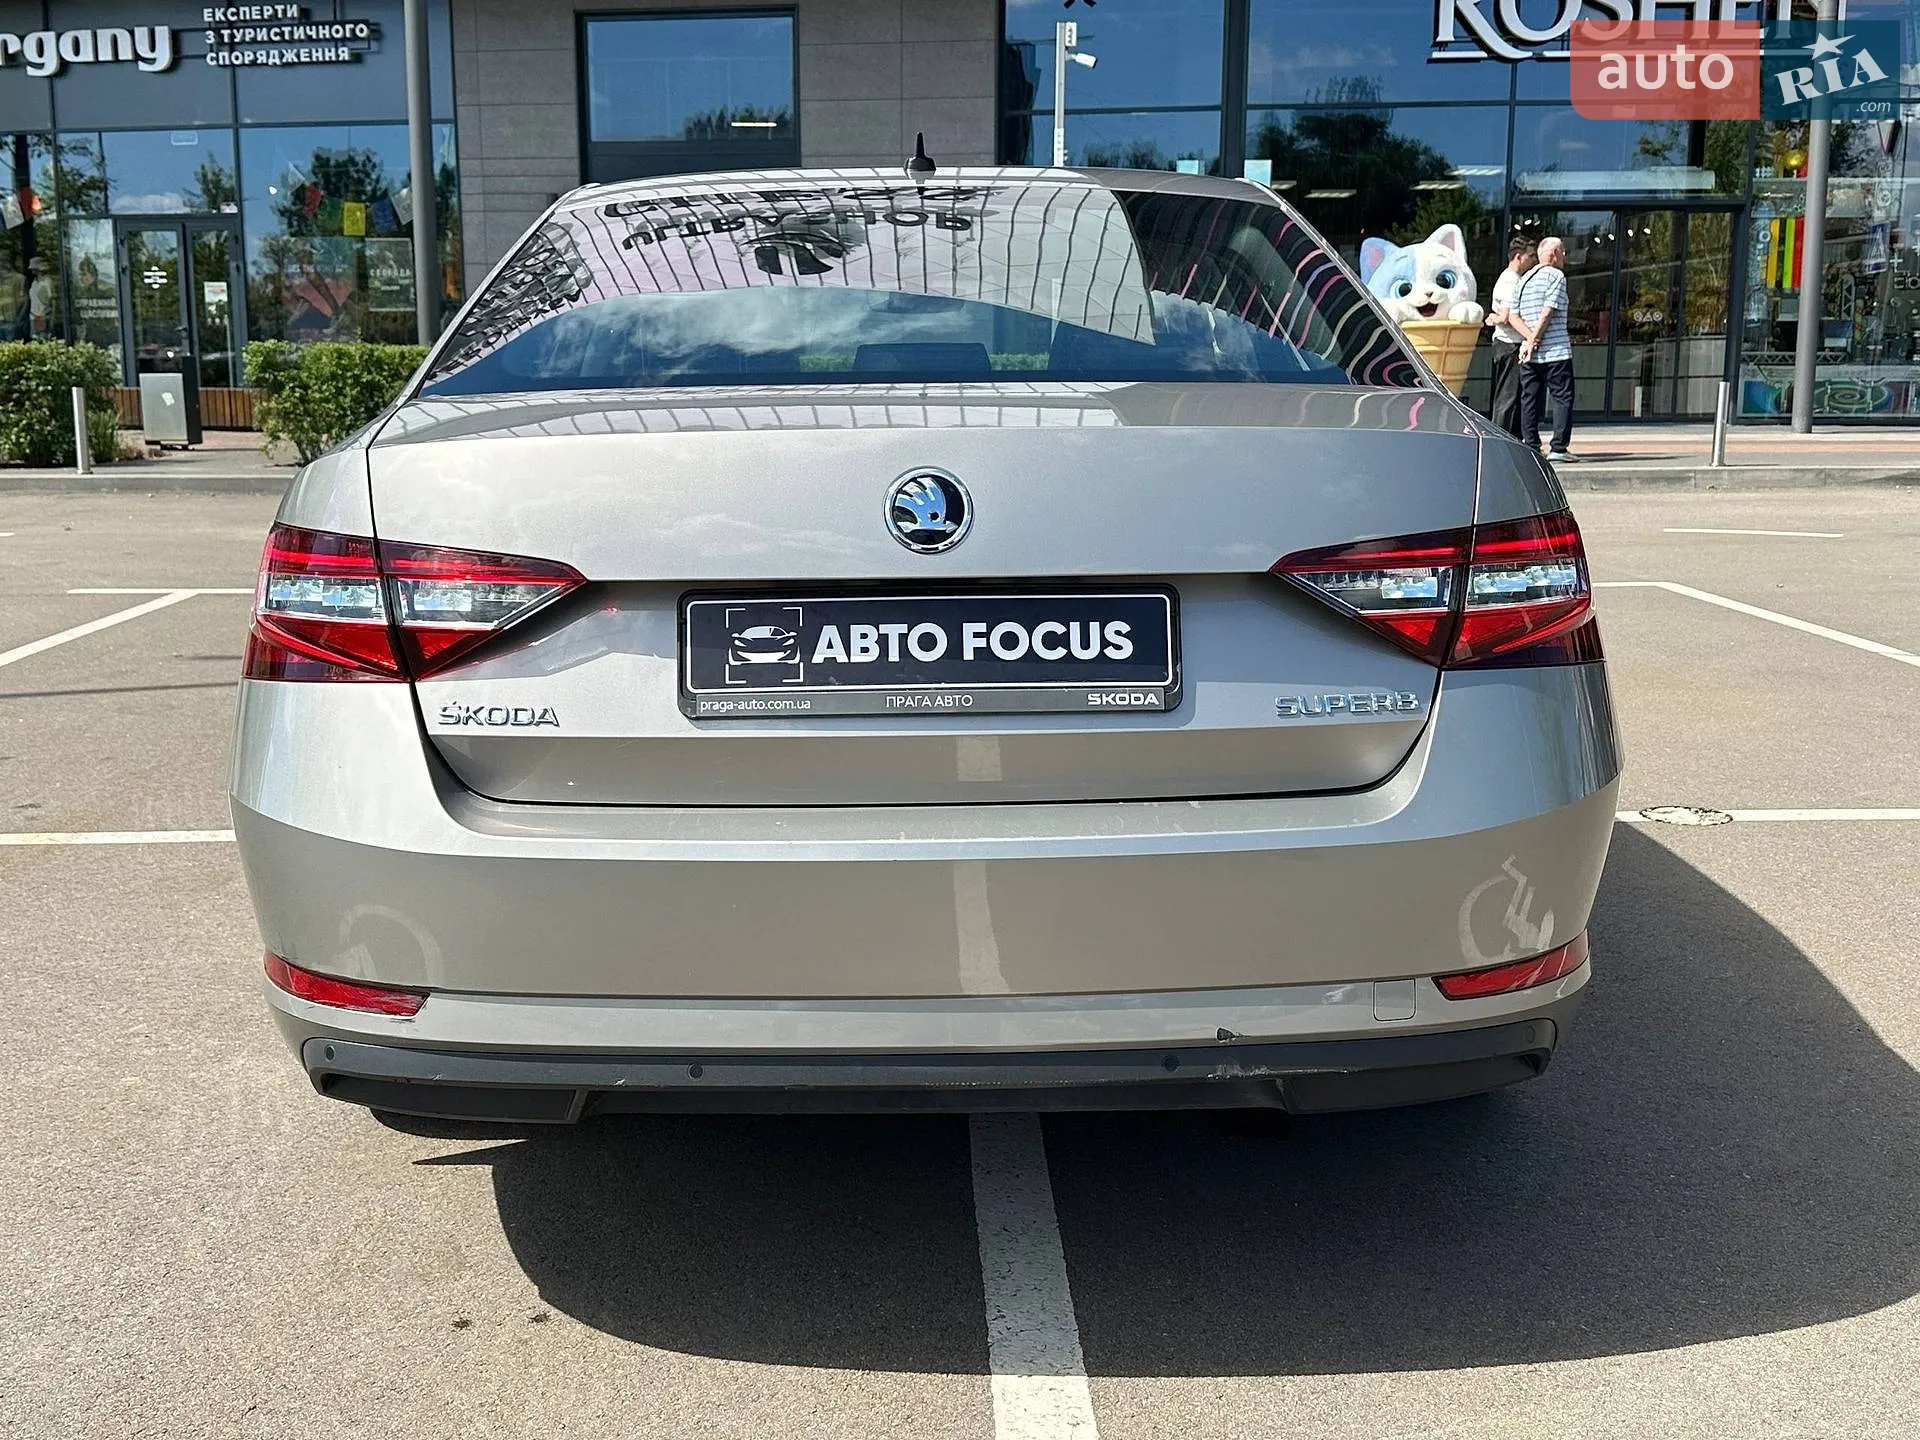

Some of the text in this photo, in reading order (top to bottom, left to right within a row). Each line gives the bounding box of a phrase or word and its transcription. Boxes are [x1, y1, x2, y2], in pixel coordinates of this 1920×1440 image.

[203, 3, 299, 23] ЕКСПЕРТИ
[221, 23, 370, 44] ТУРИСТИЧНОГО
[206, 46, 350, 67] СПОРЯДЖЕННЯ
[811, 619, 1135, 664] АВТО FOCUS
[699, 698, 812, 713] praga-auto.com.ua
[885, 694, 974, 709] ПРАГА АВТО
[1274, 691, 1421, 716] SUPERB
